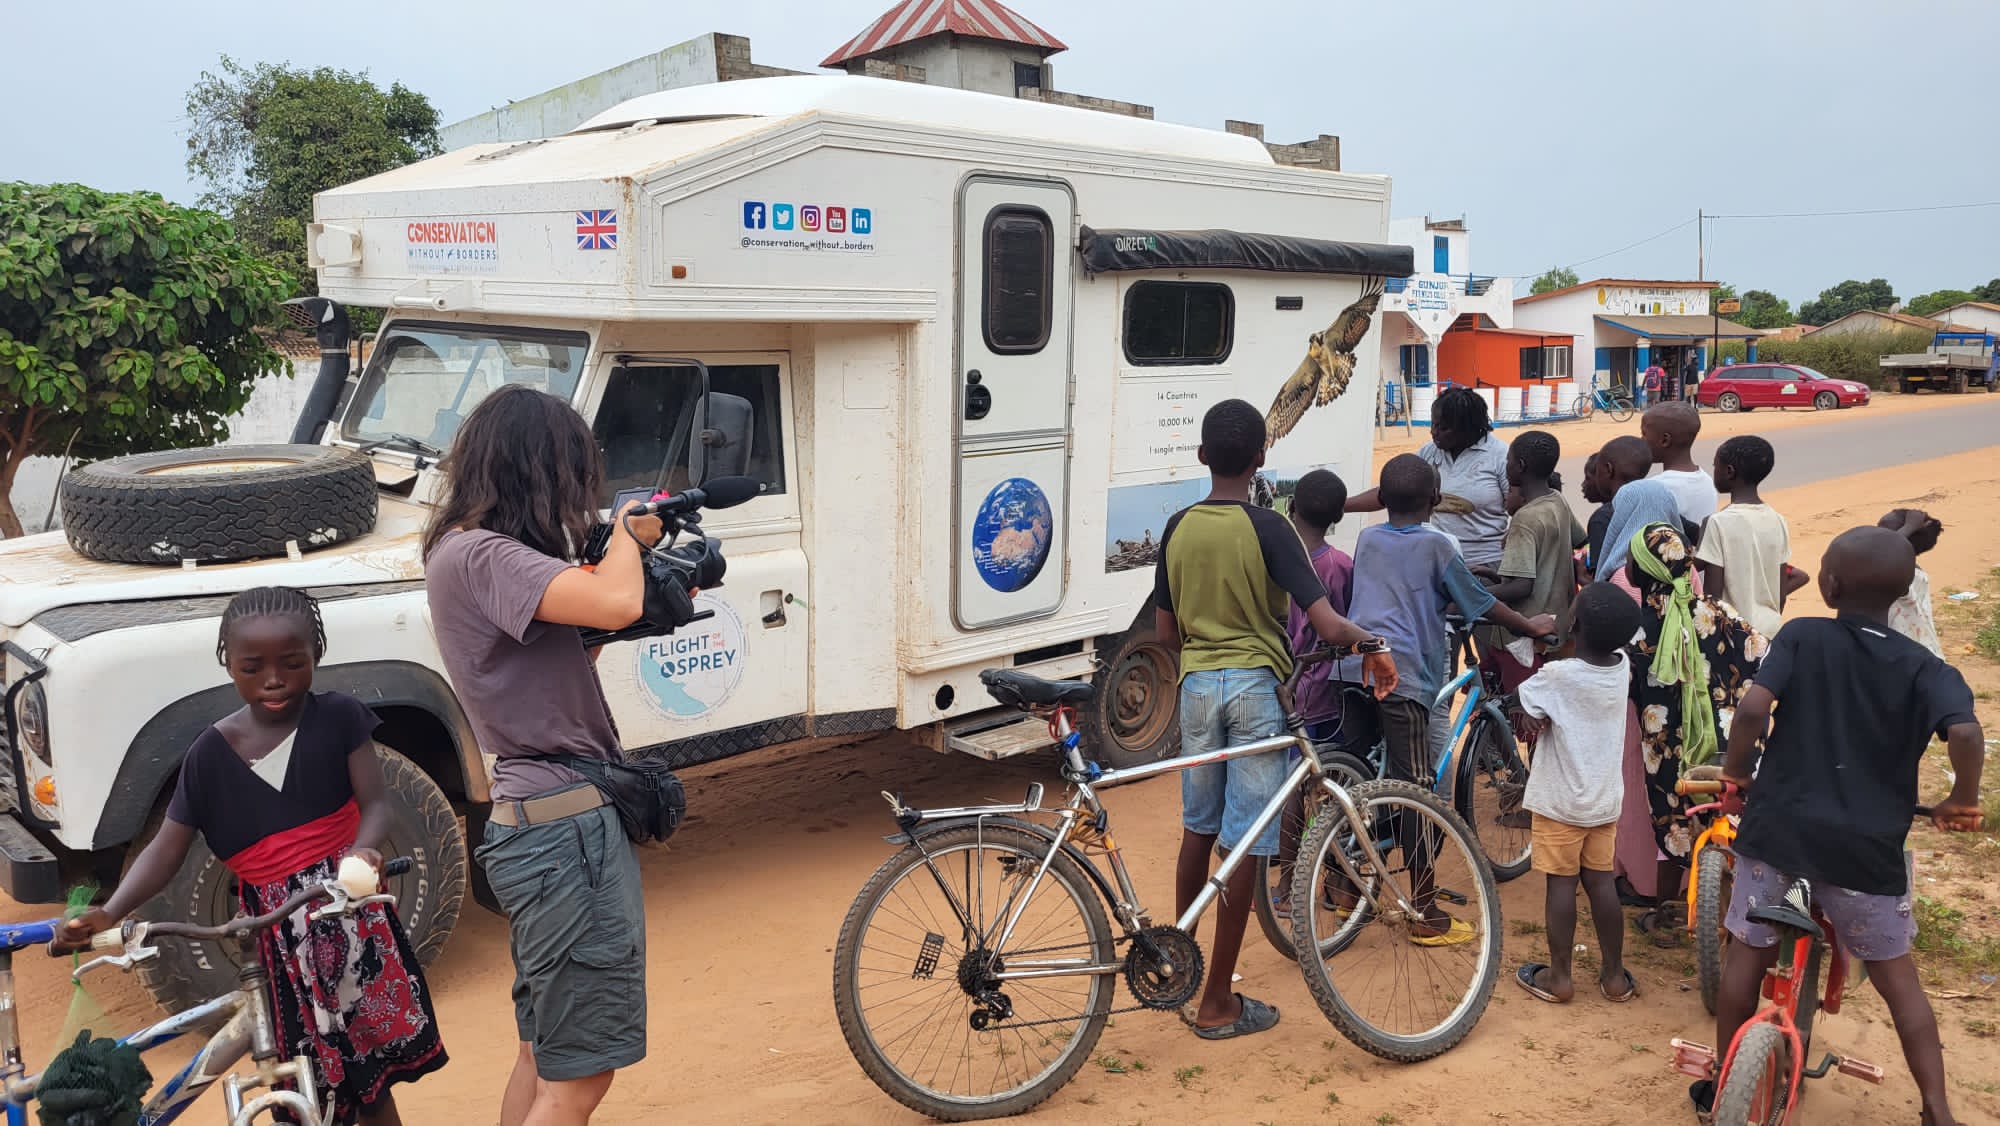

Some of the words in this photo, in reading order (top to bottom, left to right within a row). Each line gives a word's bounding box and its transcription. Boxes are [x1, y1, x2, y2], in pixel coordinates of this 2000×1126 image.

[407, 221, 496, 243] CONSERVATION
[741, 237, 874, 251] @conservation_without_borders
[408, 249, 445, 258] WITHOUT
[456, 249, 496, 260] BORDERS
[1157, 391, 1164, 400] 14
[1166, 391, 1198, 400] Countries
[1182, 416, 1194, 425] KM
[1154, 443, 1174, 456] single
[649, 634, 710, 659] FLIGHT
[713, 640, 725, 648] THE
[660, 649, 737, 678] OSPREY
